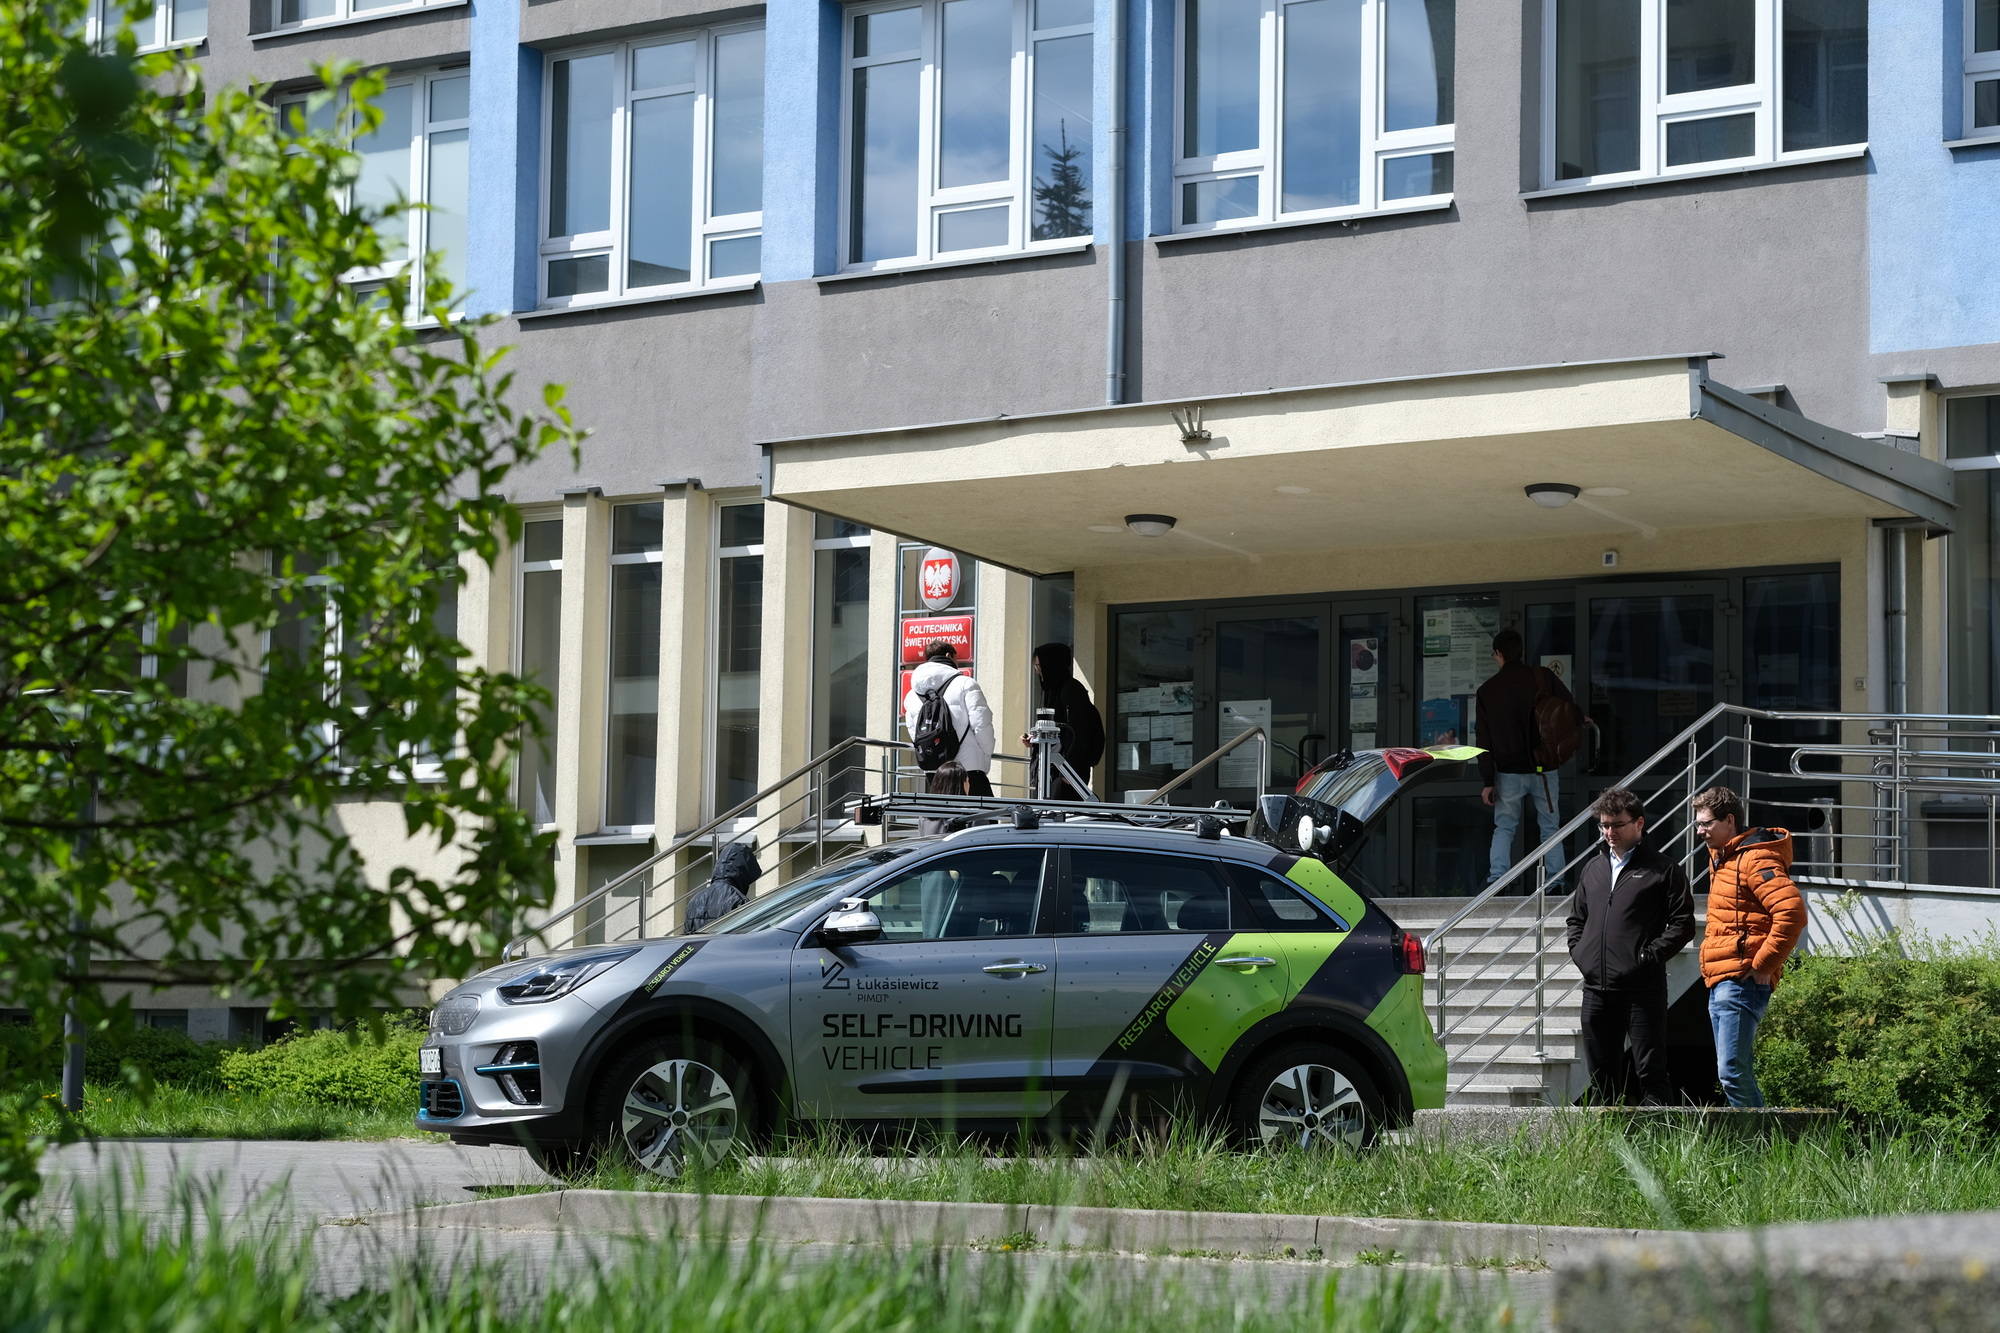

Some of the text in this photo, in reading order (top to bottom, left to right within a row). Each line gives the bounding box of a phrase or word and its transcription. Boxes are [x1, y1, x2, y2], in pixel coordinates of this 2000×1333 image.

[909, 623, 963, 634] POLITECHNIKA
[644, 945, 695, 993] RESEARCH VEHICLE
[856, 978, 939, 990] Łukasiewicz
[857, 994, 888, 1003] PIMOT
[1117, 942, 1217, 1051] RESEARCH VEHICLE
[822, 1013, 1022, 1038] SELF-DRIVING
[822, 1046, 943, 1070] VEHICLE
